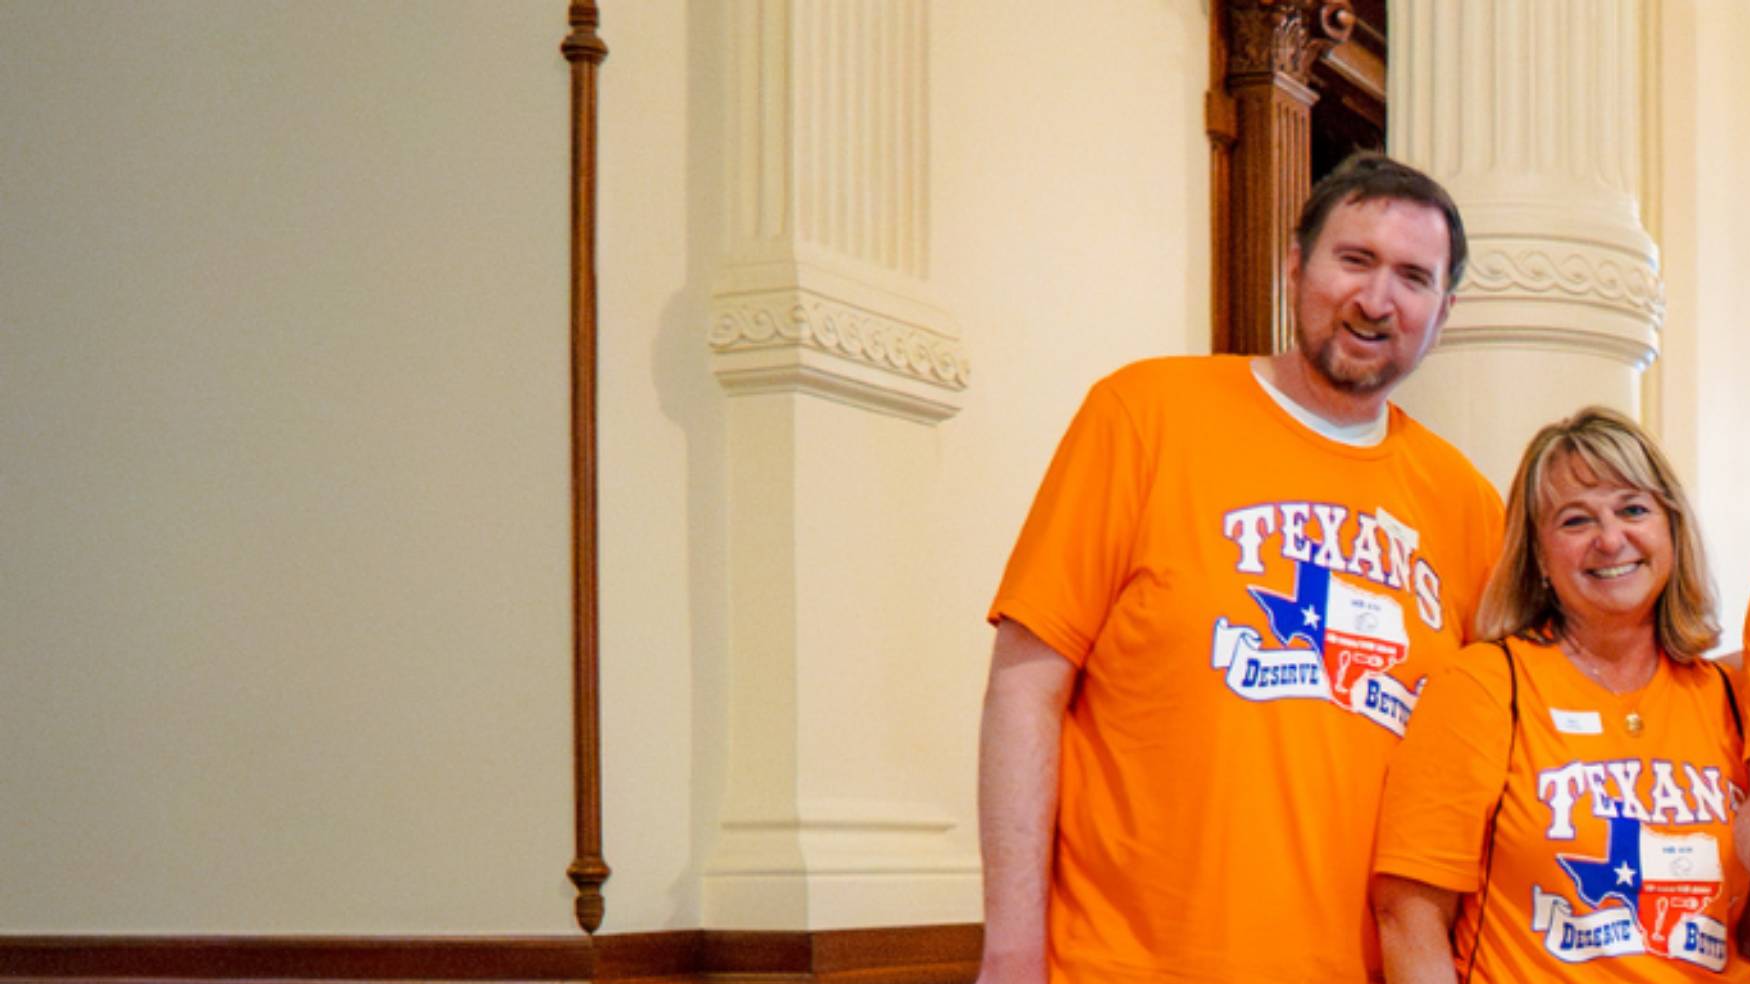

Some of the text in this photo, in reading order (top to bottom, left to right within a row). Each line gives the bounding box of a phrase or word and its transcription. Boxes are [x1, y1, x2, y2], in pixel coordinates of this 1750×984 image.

[1222, 500, 1443, 632] TEXANS
[1241, 657, 1319, 688] DESERVE
[1560, 919, 1631, 950] DESERVE
